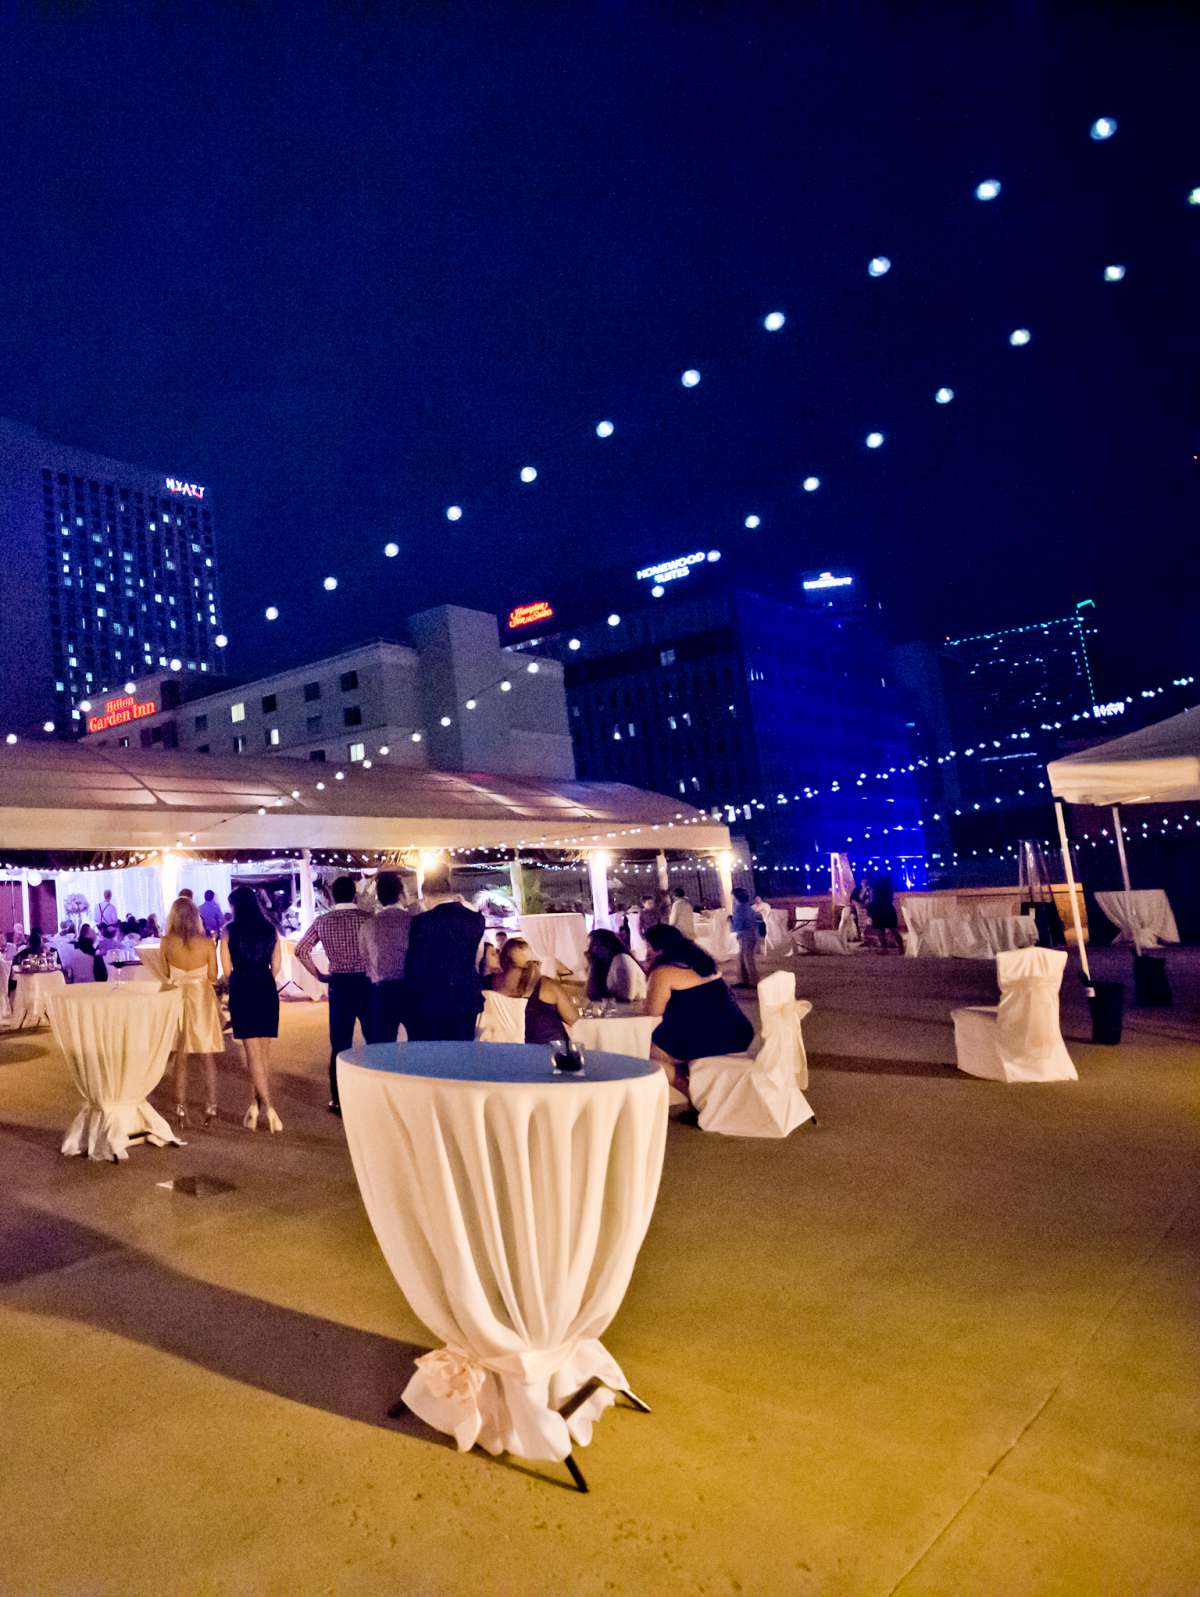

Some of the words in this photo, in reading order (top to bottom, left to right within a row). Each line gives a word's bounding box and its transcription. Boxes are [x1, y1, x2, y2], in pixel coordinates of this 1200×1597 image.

[166, 478, 204, 498] HYATT
[637, 552, 705, 580] HOMEWOOD
[106, 696, 135, 713] Hilton
[88, 709, 131, 733] Garden
[132, 701, 156, 719] Inn
